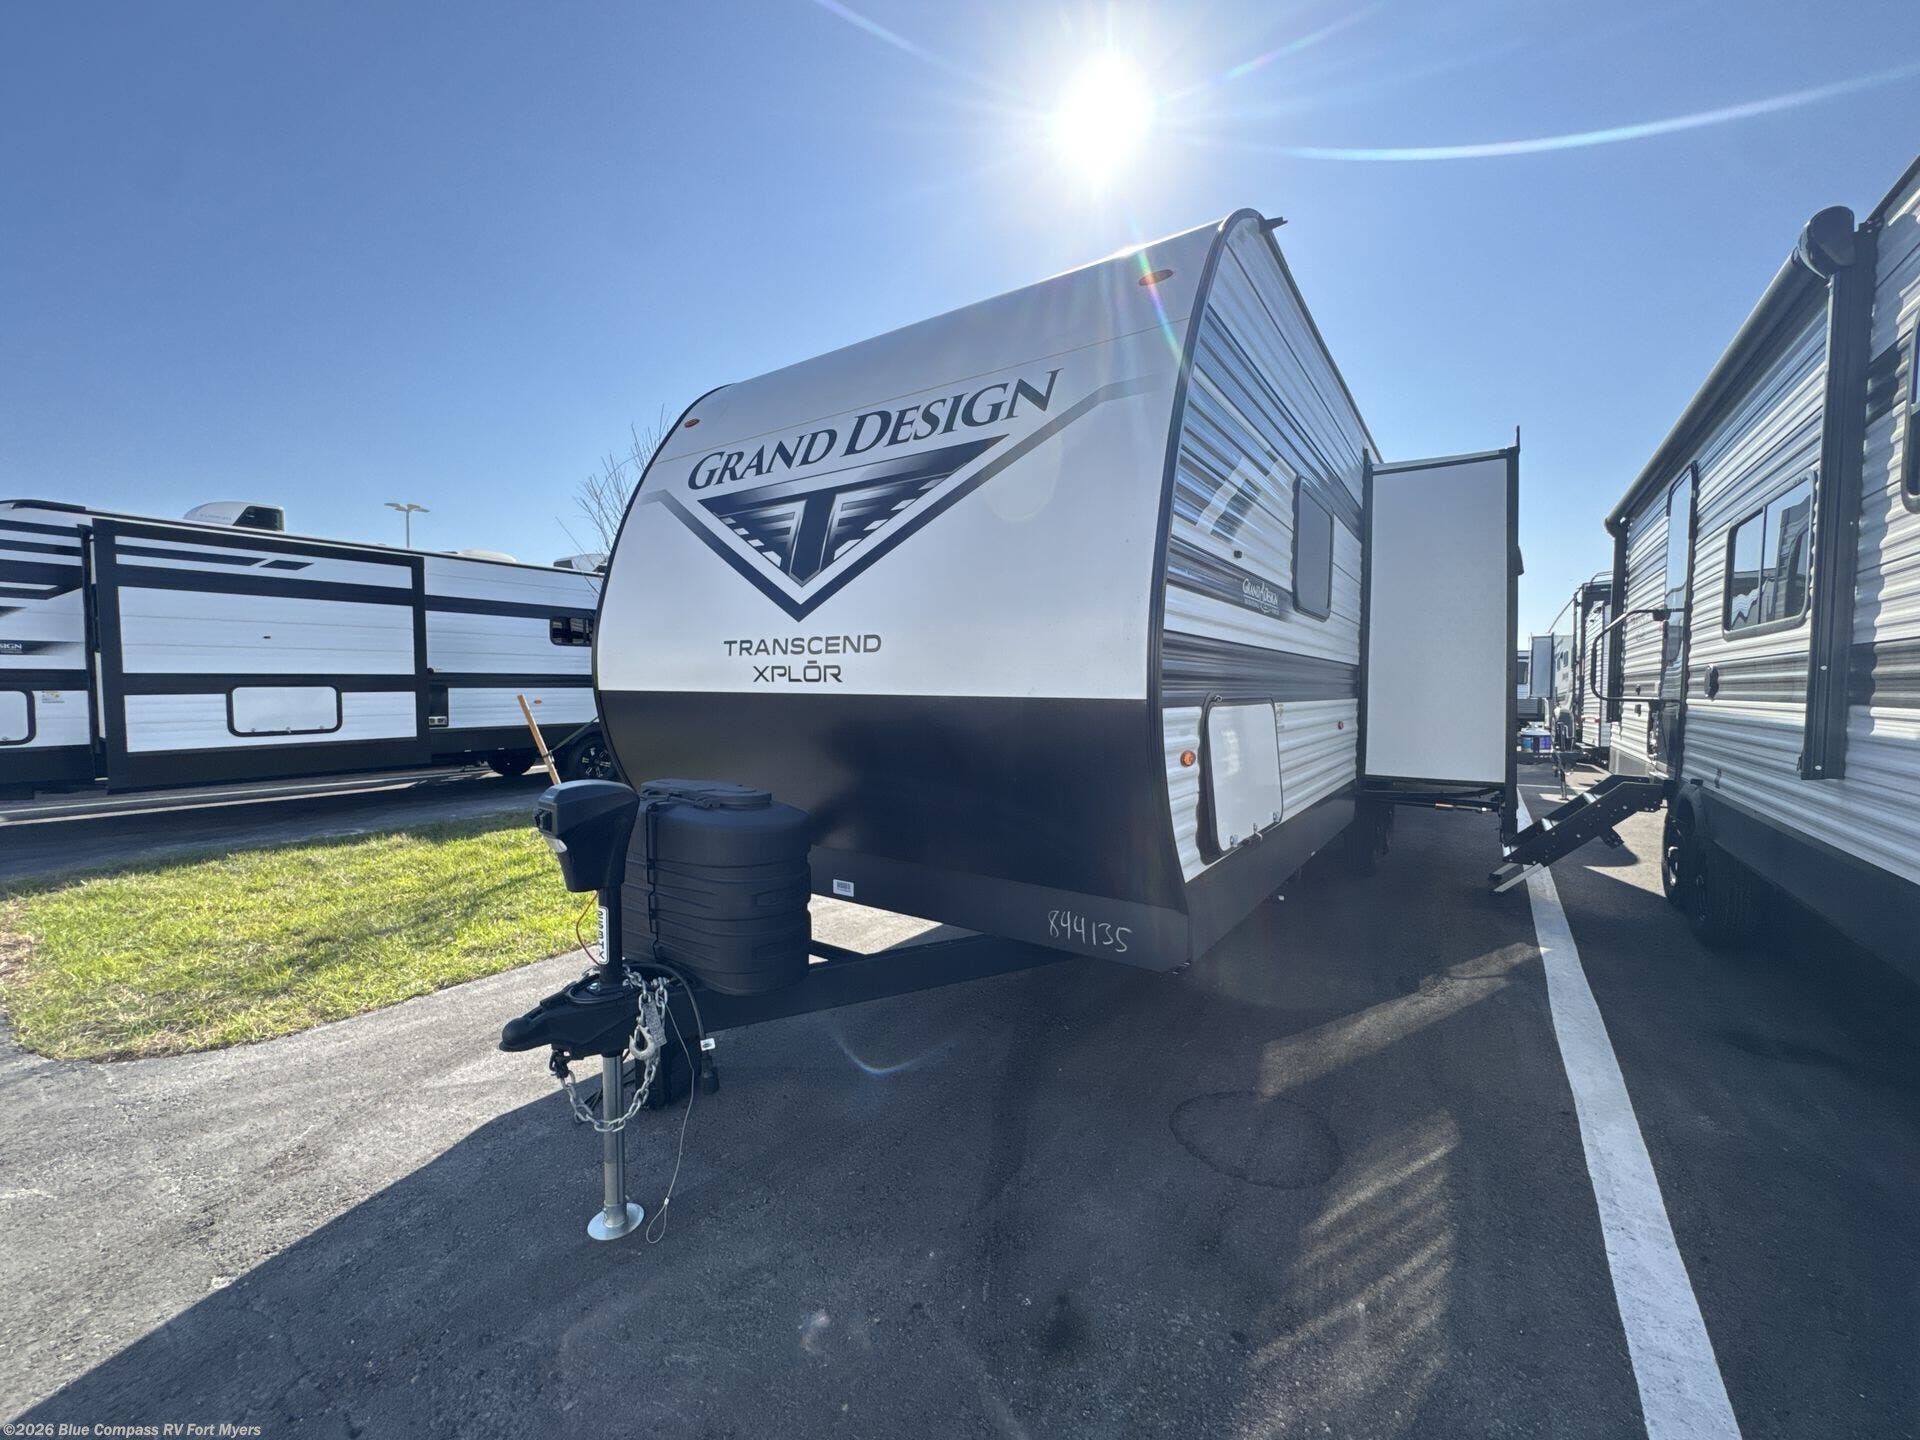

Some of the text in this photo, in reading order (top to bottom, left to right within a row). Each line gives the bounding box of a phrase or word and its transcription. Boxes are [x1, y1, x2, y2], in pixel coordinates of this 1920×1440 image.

[687, 367, 1064, 491] GRAND DESIGN
[723, 634, 882, 657] TRANSCEND
[1048, 910, 1132, 952] 844135
